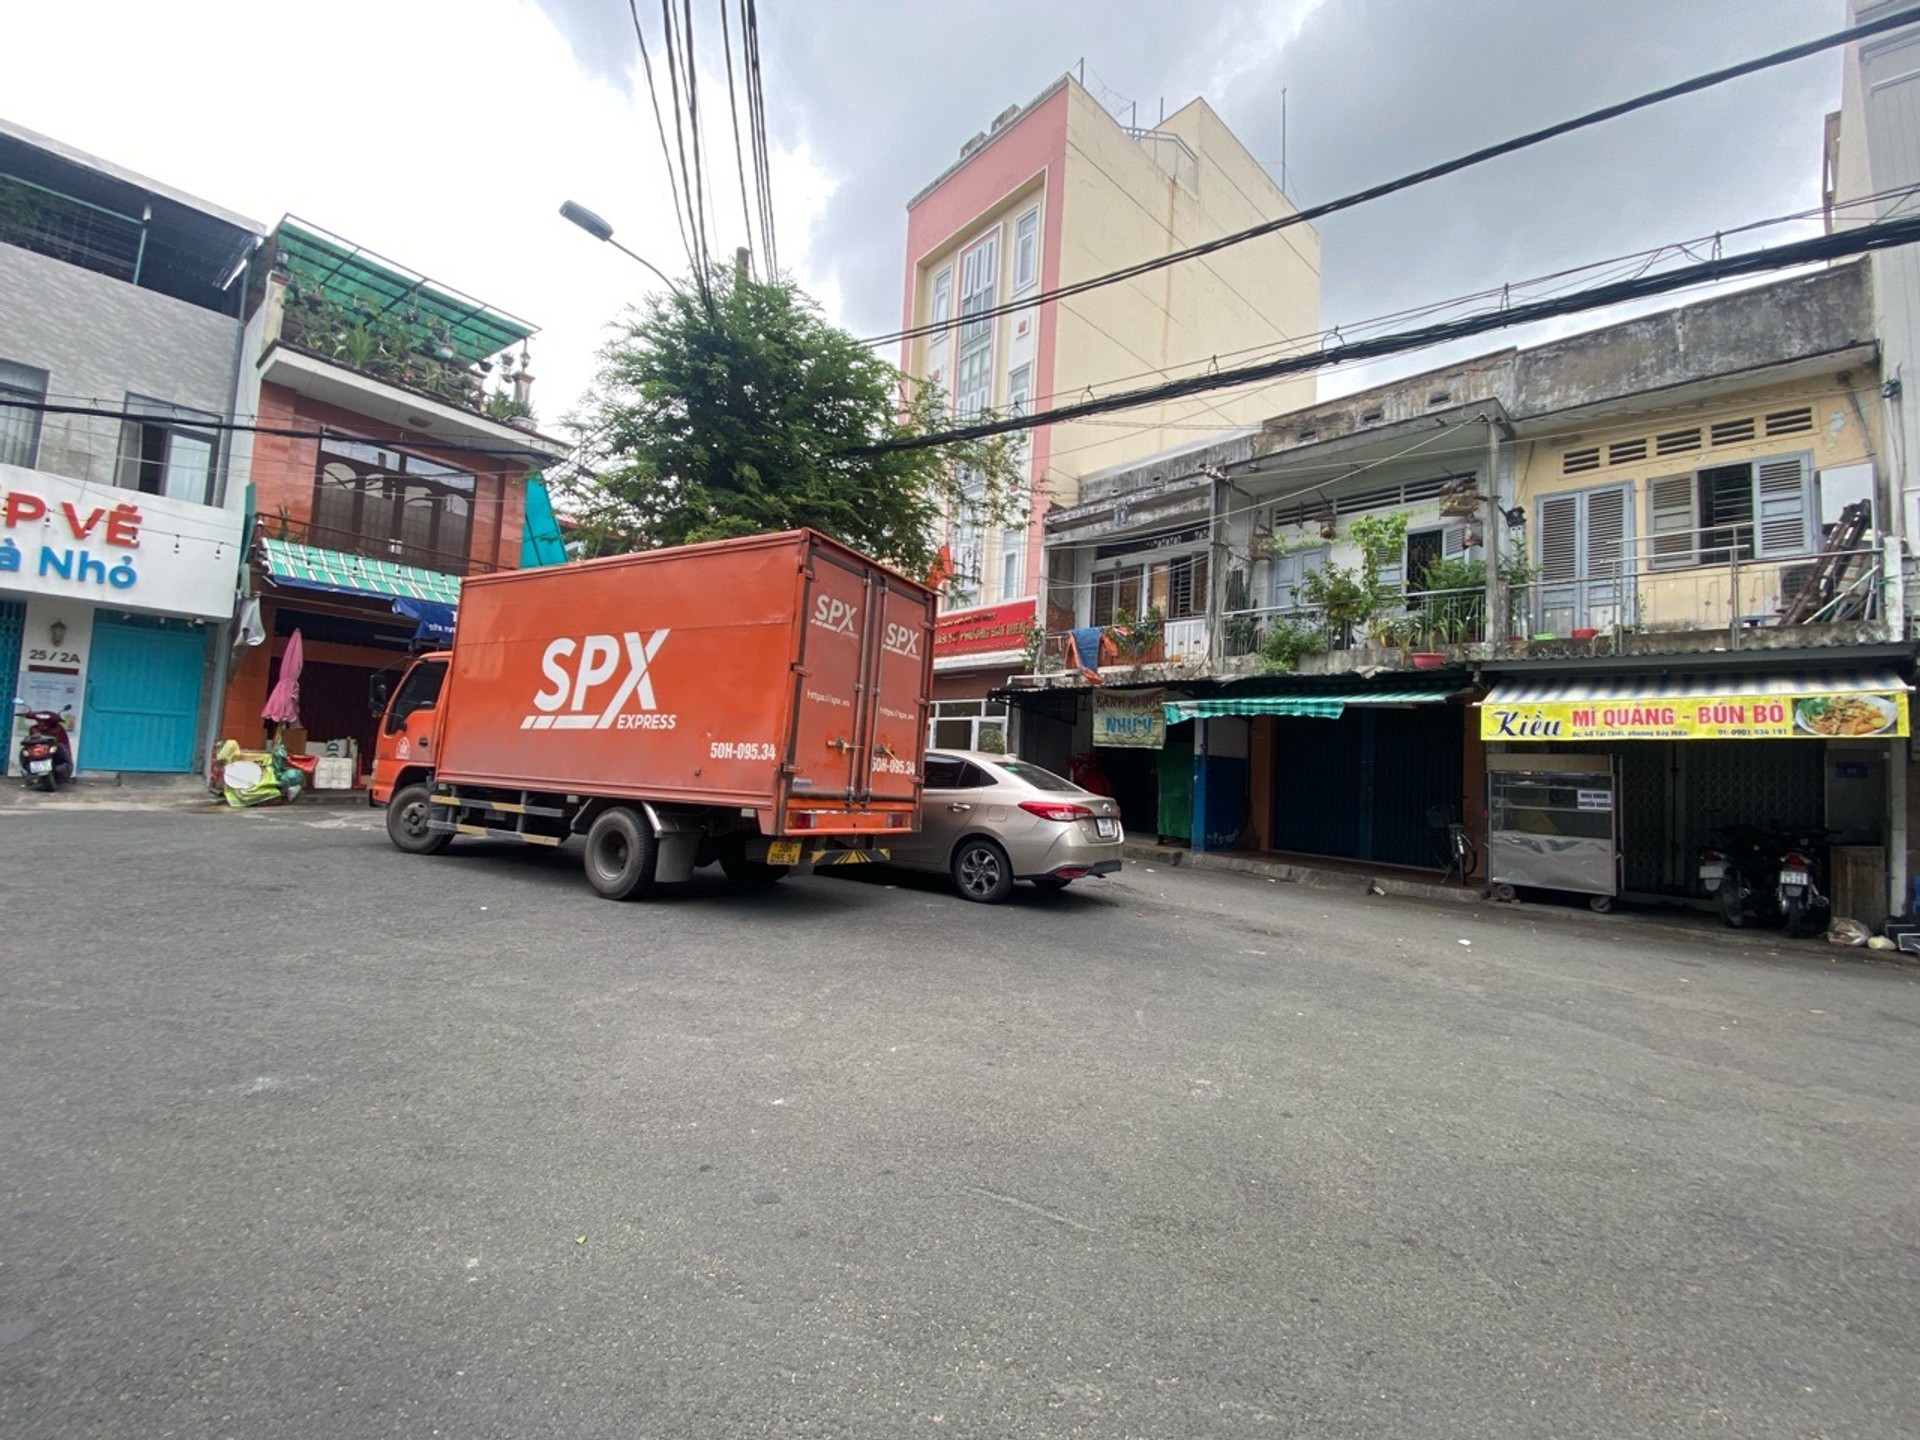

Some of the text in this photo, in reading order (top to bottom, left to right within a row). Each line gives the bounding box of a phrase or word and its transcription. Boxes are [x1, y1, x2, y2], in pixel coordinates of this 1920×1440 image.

[60, 502, 142, 550] VẼ
[39, 545, 137, 589] Nhỏ
[815, 594, 857, 633] SPX
[886, 622, 919, 656] SPX
[29, 649, 47, 661] 25
[60, 652, 80, 664] 2A
[533, 628, 671, 728] SPX
[616, 714, 677, 729] EXPRESS
[1490, 709, 1560, 736] Kiều
[1603, 702, 1674, 727] QUẢNG
[1698, 702, 1744, 724] BÚN
[710, 742, 777, 760] 50H-095.34
